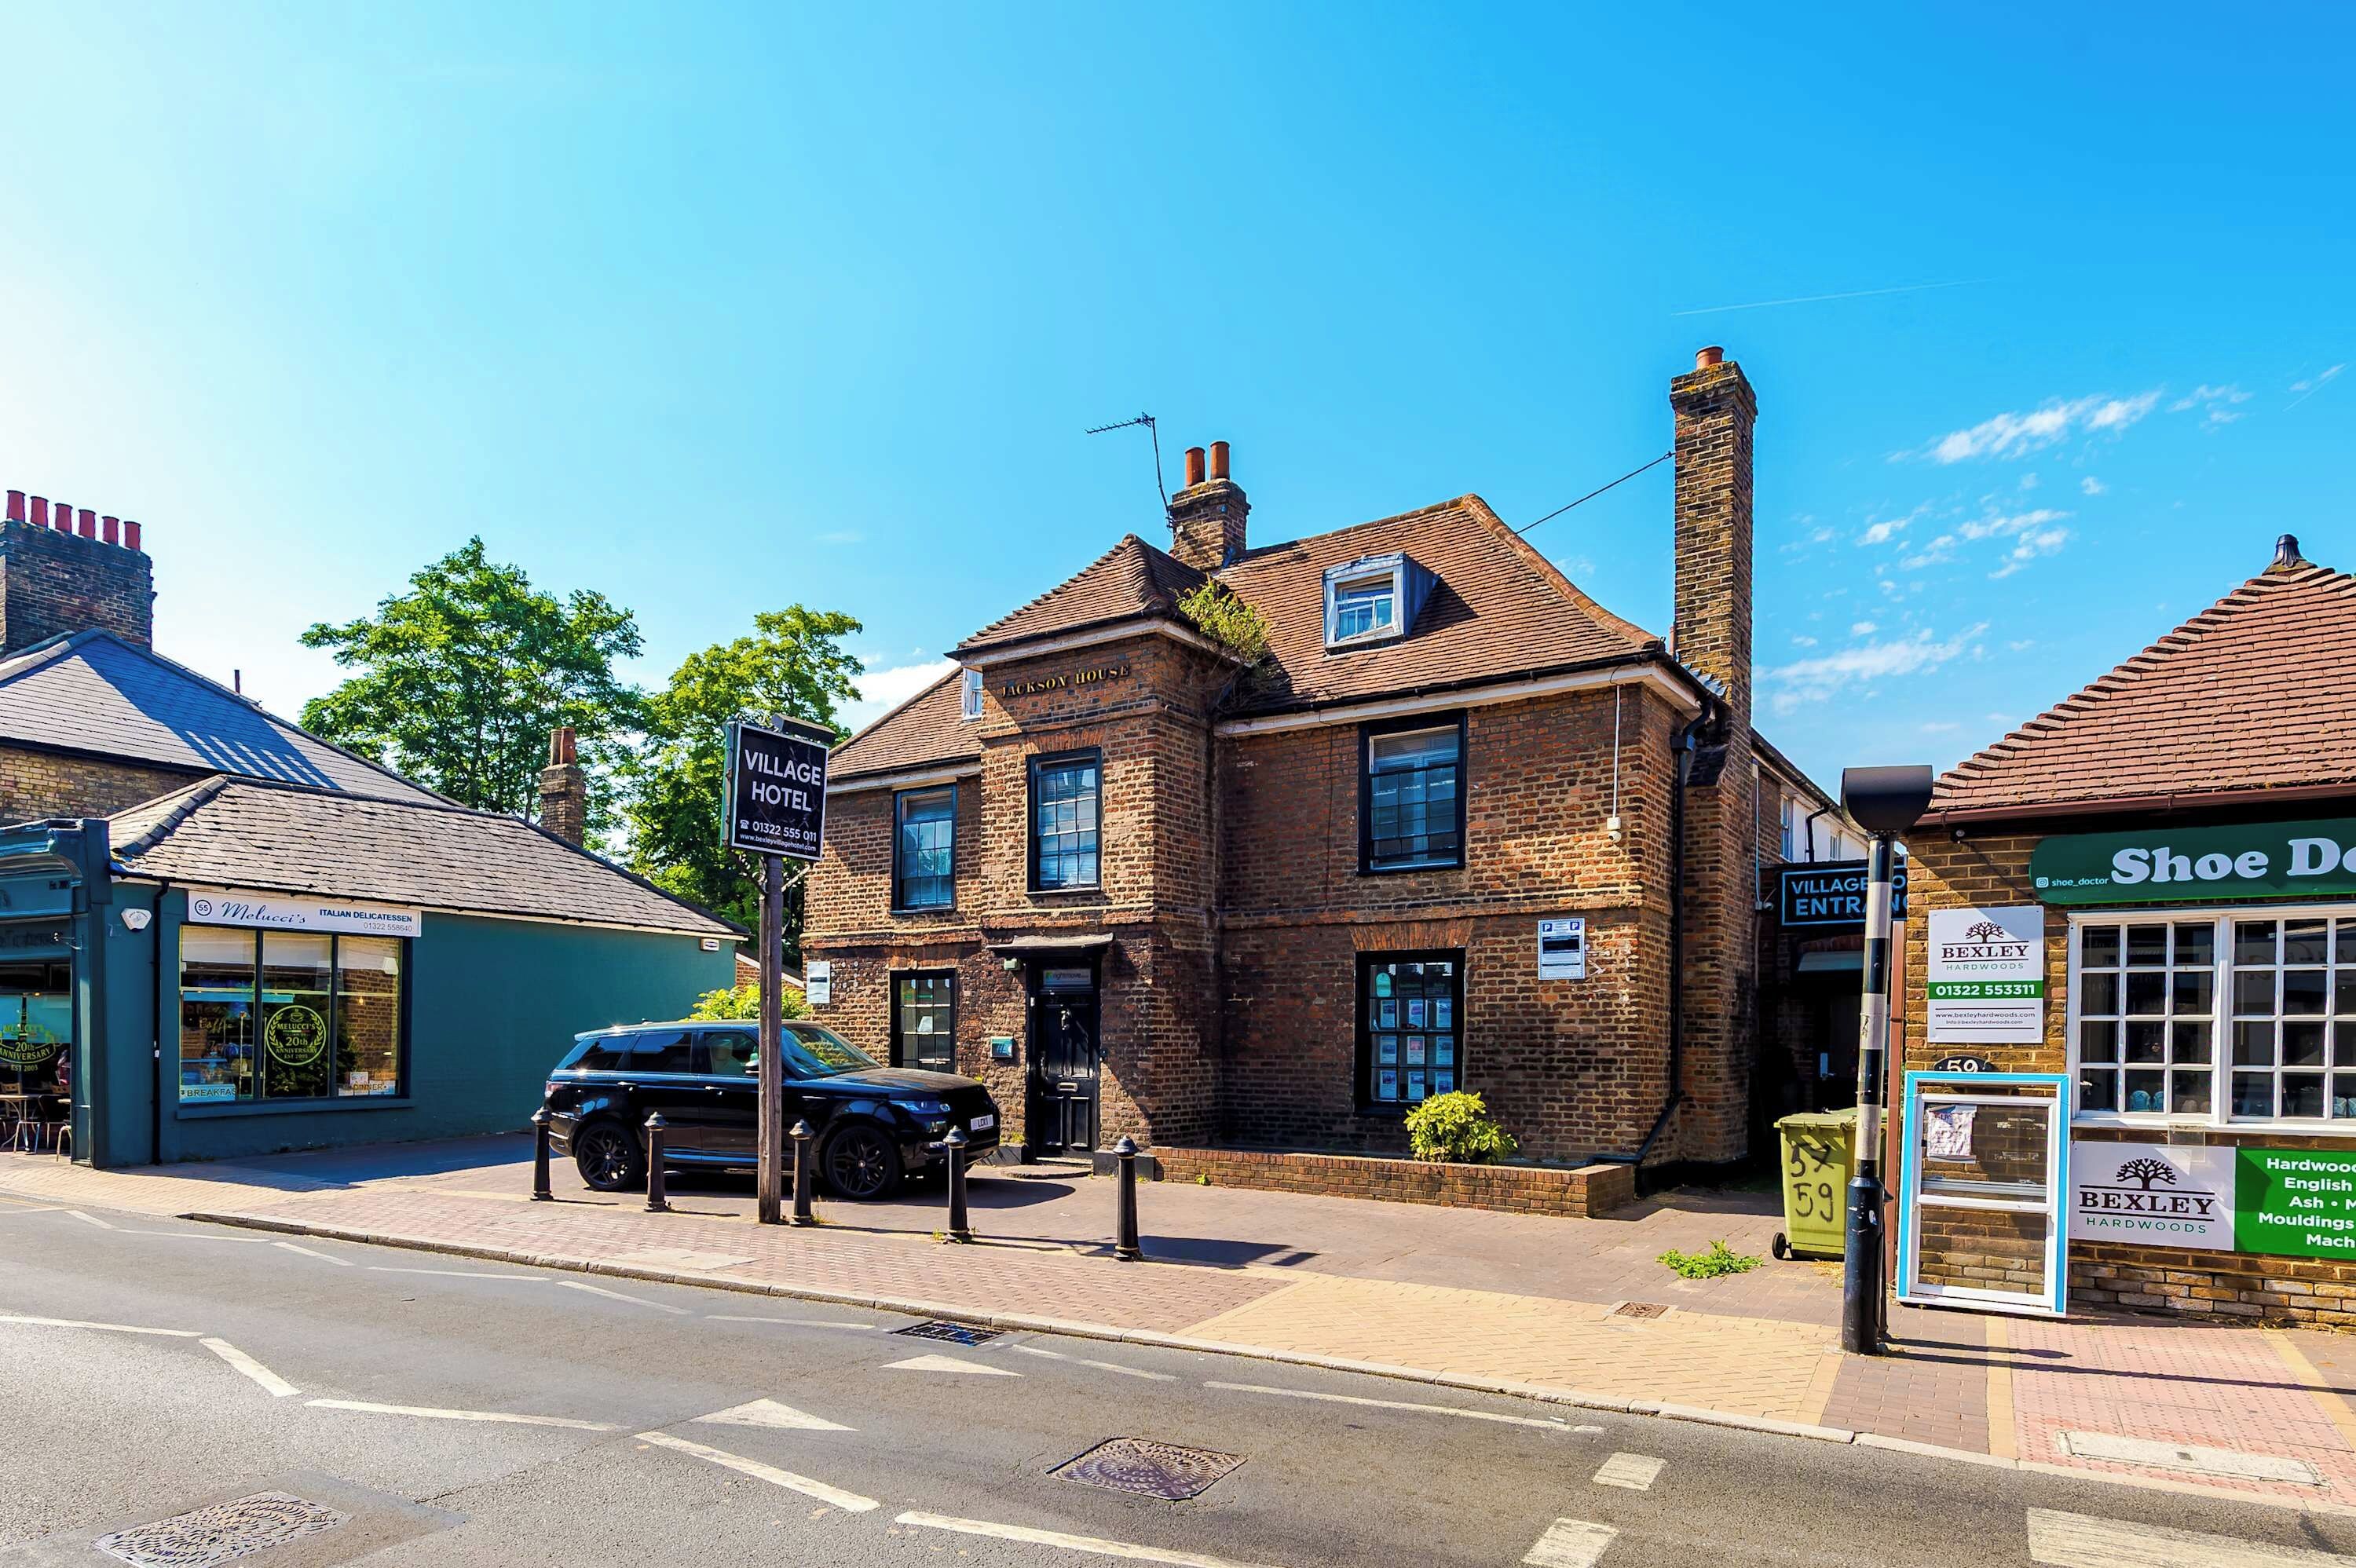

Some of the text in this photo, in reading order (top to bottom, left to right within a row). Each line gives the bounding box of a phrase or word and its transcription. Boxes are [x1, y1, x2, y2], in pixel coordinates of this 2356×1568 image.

[1001, 665, 1129, 697] JACKSON HOUSE
[744, 749, 821, 786] VILLAGE
[752, 781, 812, 813] HOTEL
[752, 821, 817, 842] 01322 555 011
[740, 834, 817, 852] www.bexleyvillagehotel.com
[2111, 846, 2269, 885] Shoe
[1791, 876, 1868, 894] VILLAGE
[2051, 876, 2109, 887] shoe_doctor
[221, 901, 306, 924] Melucci's
[320, 908, 412, 923] ITALIAN DELICATESSEN
[364, 922, 386, 930] 01322
[1941, 945, 2029, 959] BEXLEY
[1936, 984, 2035, 996] 01322 553311
[16, 1041, 35, 1052] 20th
[286, 1036, 308, 1047] 20th
[1947, 1059, 1978, 1072] 59
[2285, 1176, 2353, 1192] English
[1794, 1182, 1834, 1223] 59
[2079, 1190, 2215, 1215] BEXLEY
[2288, 1195, 2324, 1208] Ash
[2087, 1217, 2207, 1234] HARDWOODS
[2259, 1212, 2354, 1231] Mouldings
